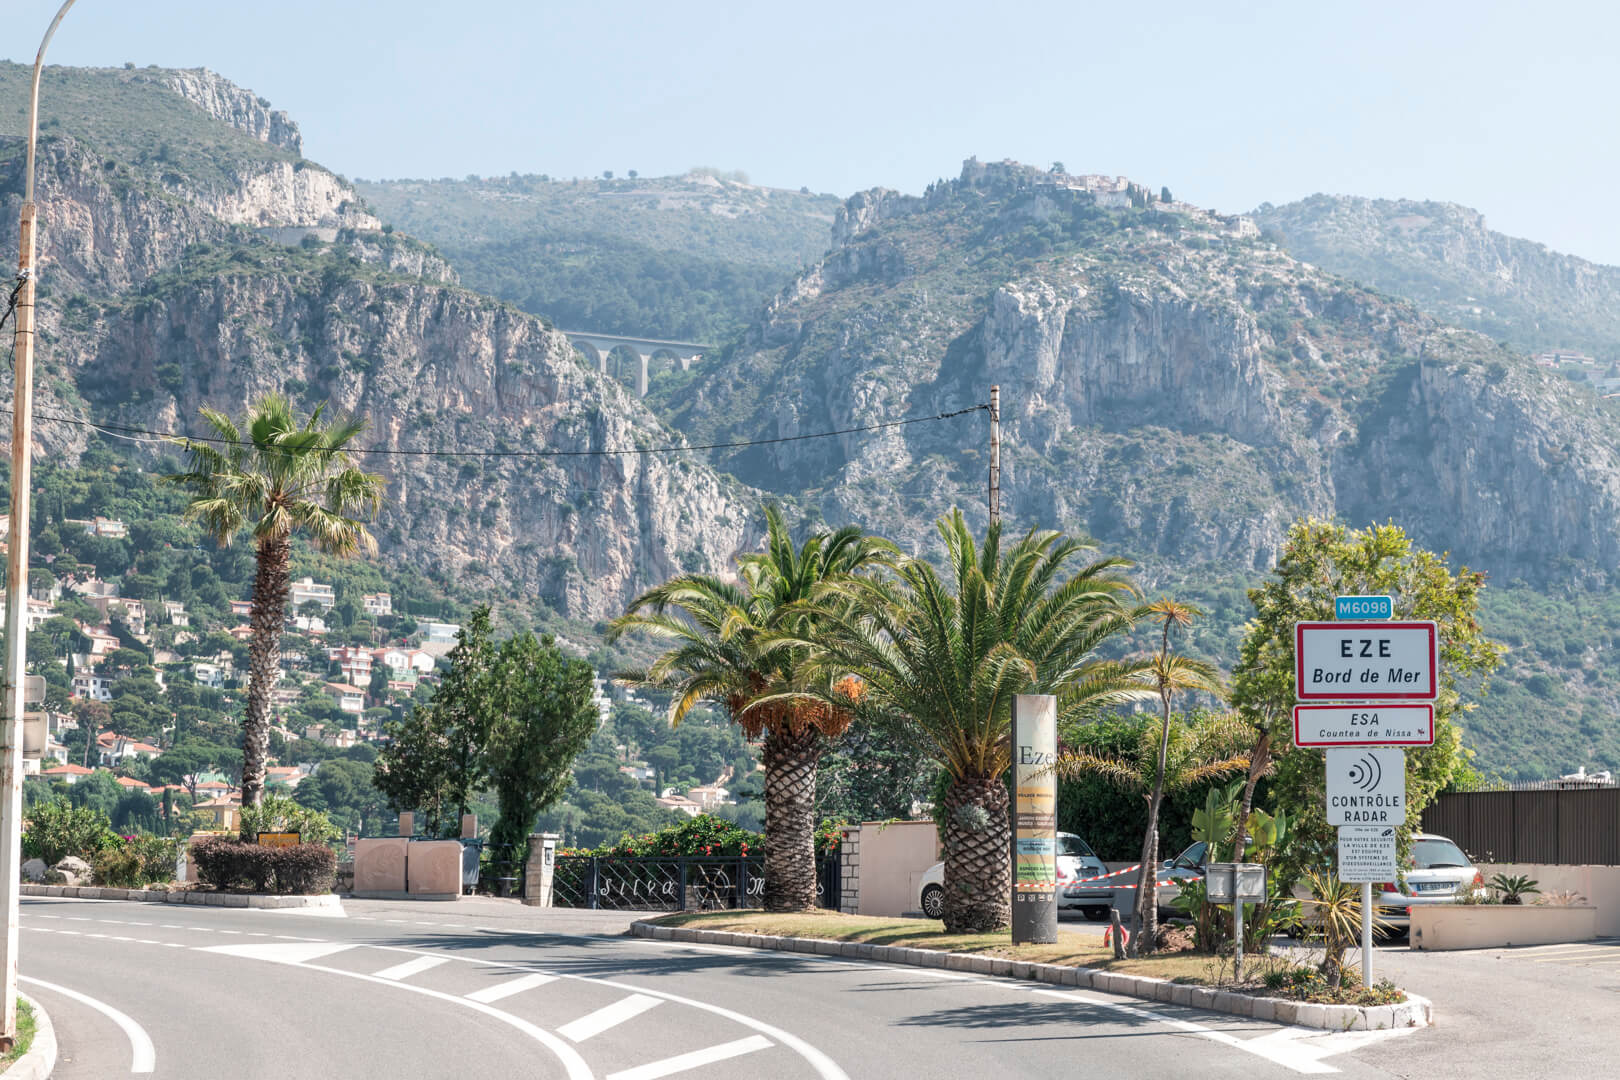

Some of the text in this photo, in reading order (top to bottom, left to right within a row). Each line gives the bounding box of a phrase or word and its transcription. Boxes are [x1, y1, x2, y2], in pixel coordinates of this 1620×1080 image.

[1340, 601, 1388, 614] M6098
[1341, 639, 1392, 658] EZE
[1312, 667, 1421, 683] Bord de Mer
[1350, 713, 1380, 726] ESA
[1319, 728, 1412, 738] Countea de Nissa
[1017, 745, 1054, 766] Eze
[1331, 793, 1400, 808] CONTRÔLE
[1344, 810, 1388, 822] RADAR
[600, 878, 675, 896] Silva
